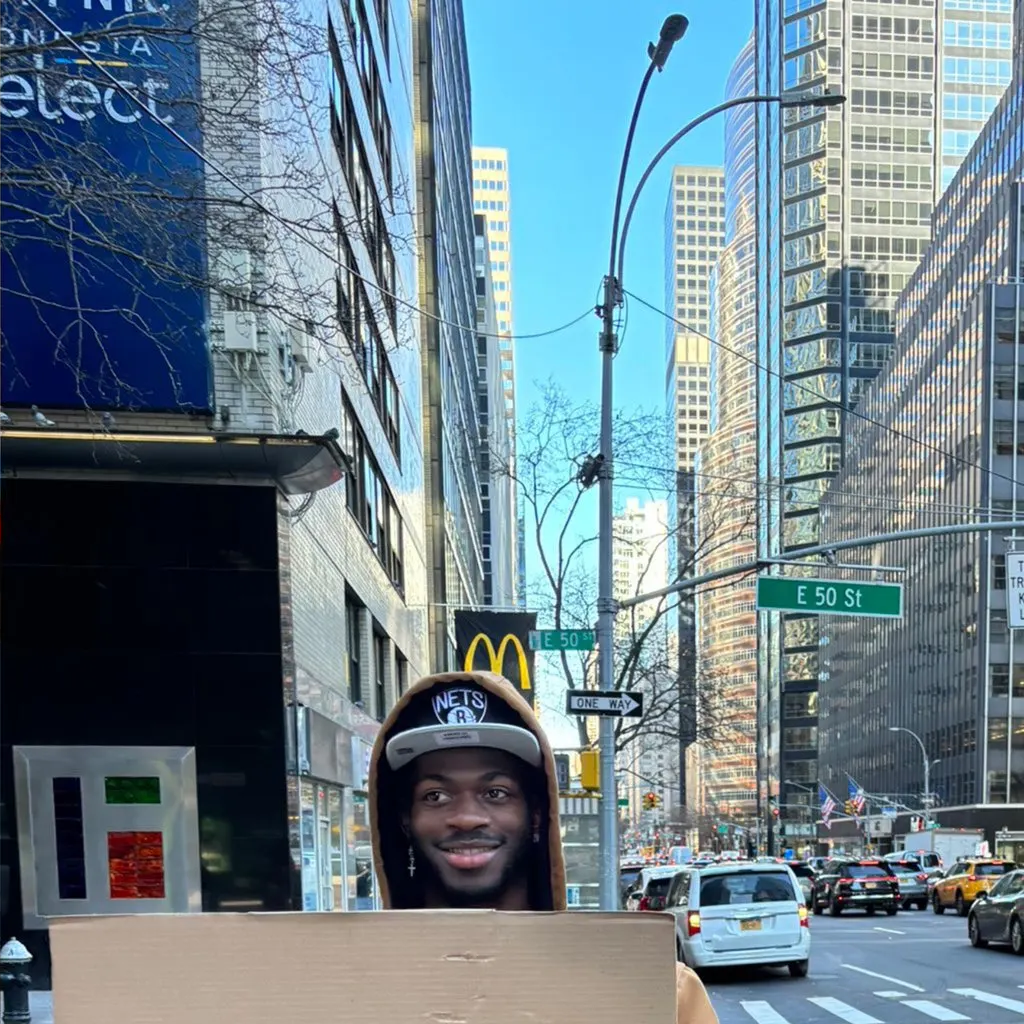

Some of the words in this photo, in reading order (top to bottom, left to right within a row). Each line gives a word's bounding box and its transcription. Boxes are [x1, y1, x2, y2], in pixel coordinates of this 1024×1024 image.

[797, 585, 807, 605] E
[815, 587, 837, 607] 50
[844, 588, 863, 608] St
[544, 633, 553, 647] E
[560, 633, 579, 647] 50
[436, 689, 484, 713] NETS
[576, 698, 599, 709] ONE
[609, 699, 632, 710] WAY
